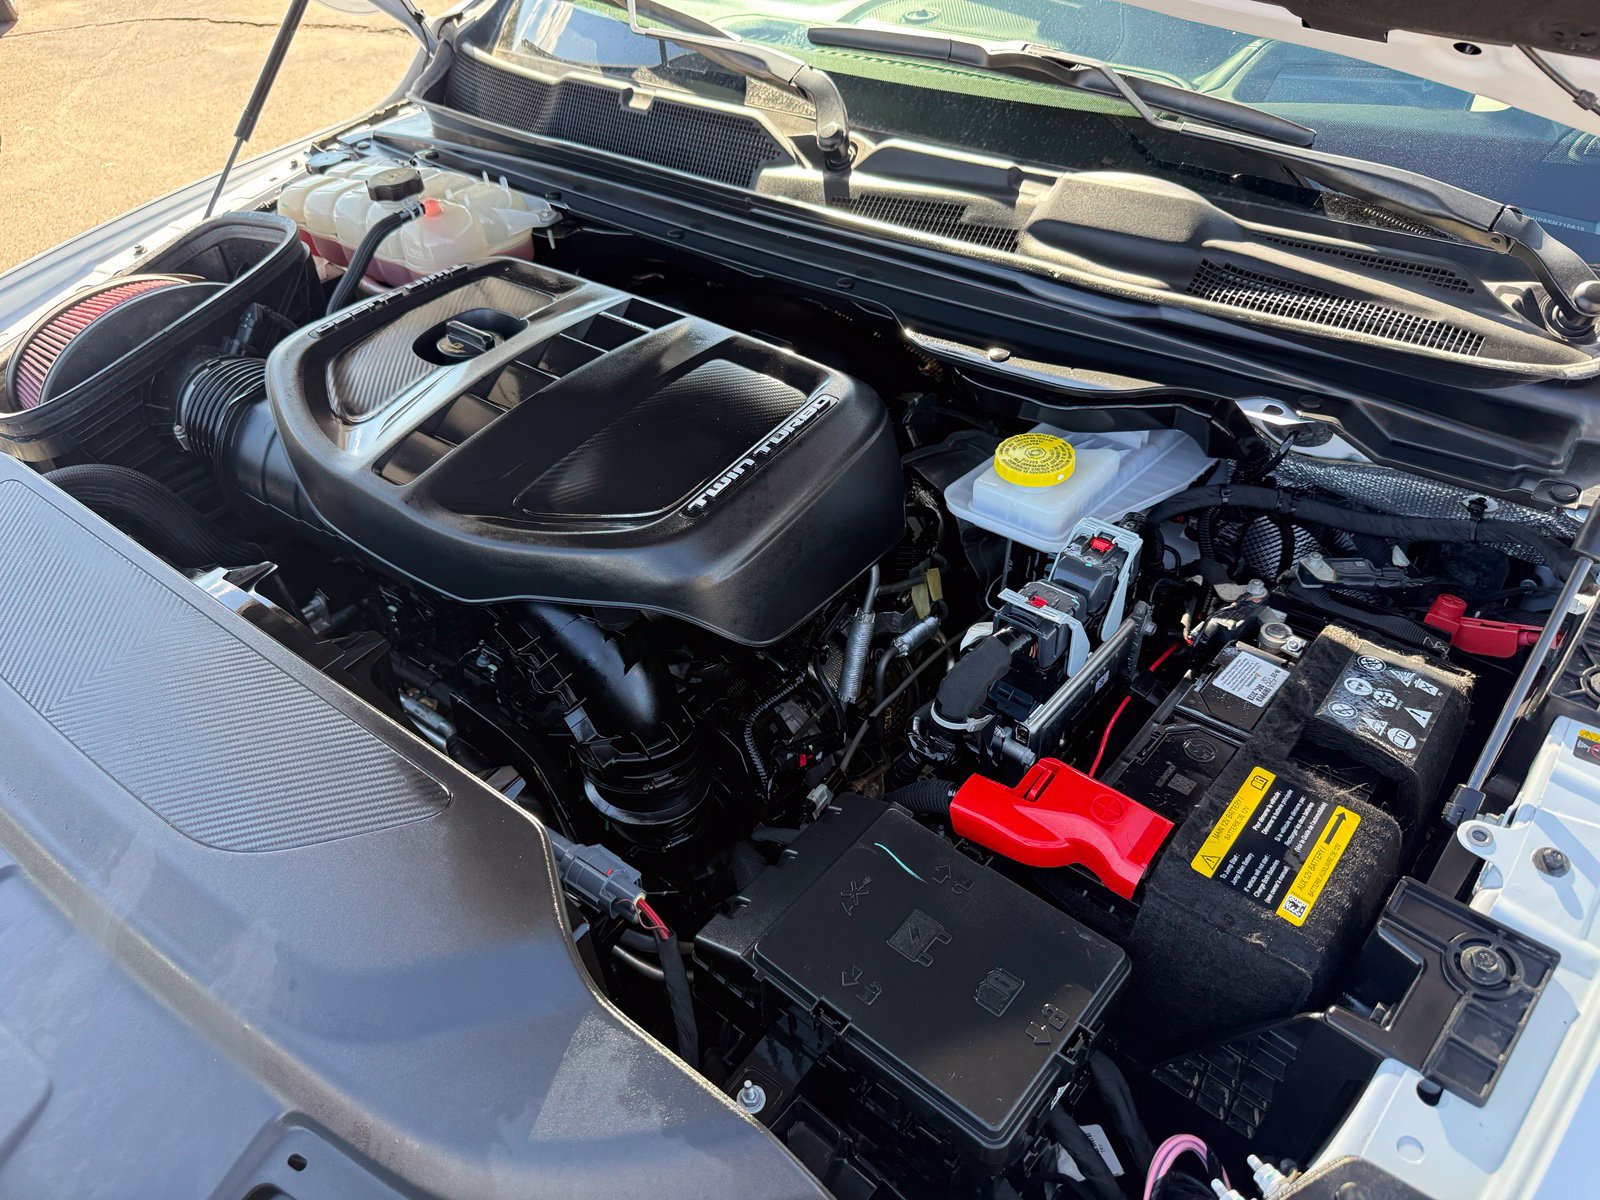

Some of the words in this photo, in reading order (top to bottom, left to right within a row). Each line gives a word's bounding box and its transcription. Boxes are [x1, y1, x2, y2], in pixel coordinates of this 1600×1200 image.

[687, 458, 755, 511] TWIN
[754, 396, 831, 457] TURBO
[1213, 826, 1225, 840] MAIN
[1221, 818, 1230, 827] 12V
[1226, 798, 1243, 819] BATTERY
[1273, 804, 1284, 816] batterie
[1281, 789, 1294, 805] principale
[1224, 819, 1241, 840] BATTERIE
[1241, 806, 1250, 814] 12V
[1252, 821, 1262, 831] Pour
[1279, 820, 1291, 834] véhicule
[1284, 828, 1299, 847] Recharger
[1303, 802, 1314, 816] batteries
[1302, 829, 1311, 840] Guide
[1224, 864, 1234, 875] Jump
[1230, 855, 1239, 864] Start
[1230, 874, 1242, 886] Jump
[1236, 865, 1245, 875] Main
[1242, 852, 1255, 867] Battery
[1246, 875, 1257, 889] vehicle
[1253, 883, 1266, 898] Charge
[1262, 874, 1270, 884] Both
[1267, 859, 1280, 875] Batteries
[1269, 880, 1281, 894] owner's
[1278, 865, 1291, 881] manual)
[1297, 878, 1307, 891] AUX
[1303, 870, 1312, 879] 12V
[1308, 849, 1324, 871] BATTERY
[1308, 876, 1323, 897] BATTERIE
[1318, 856, 1334, 878] AUXILIAIRE
[1333, 843, 1341, 852] 12V
